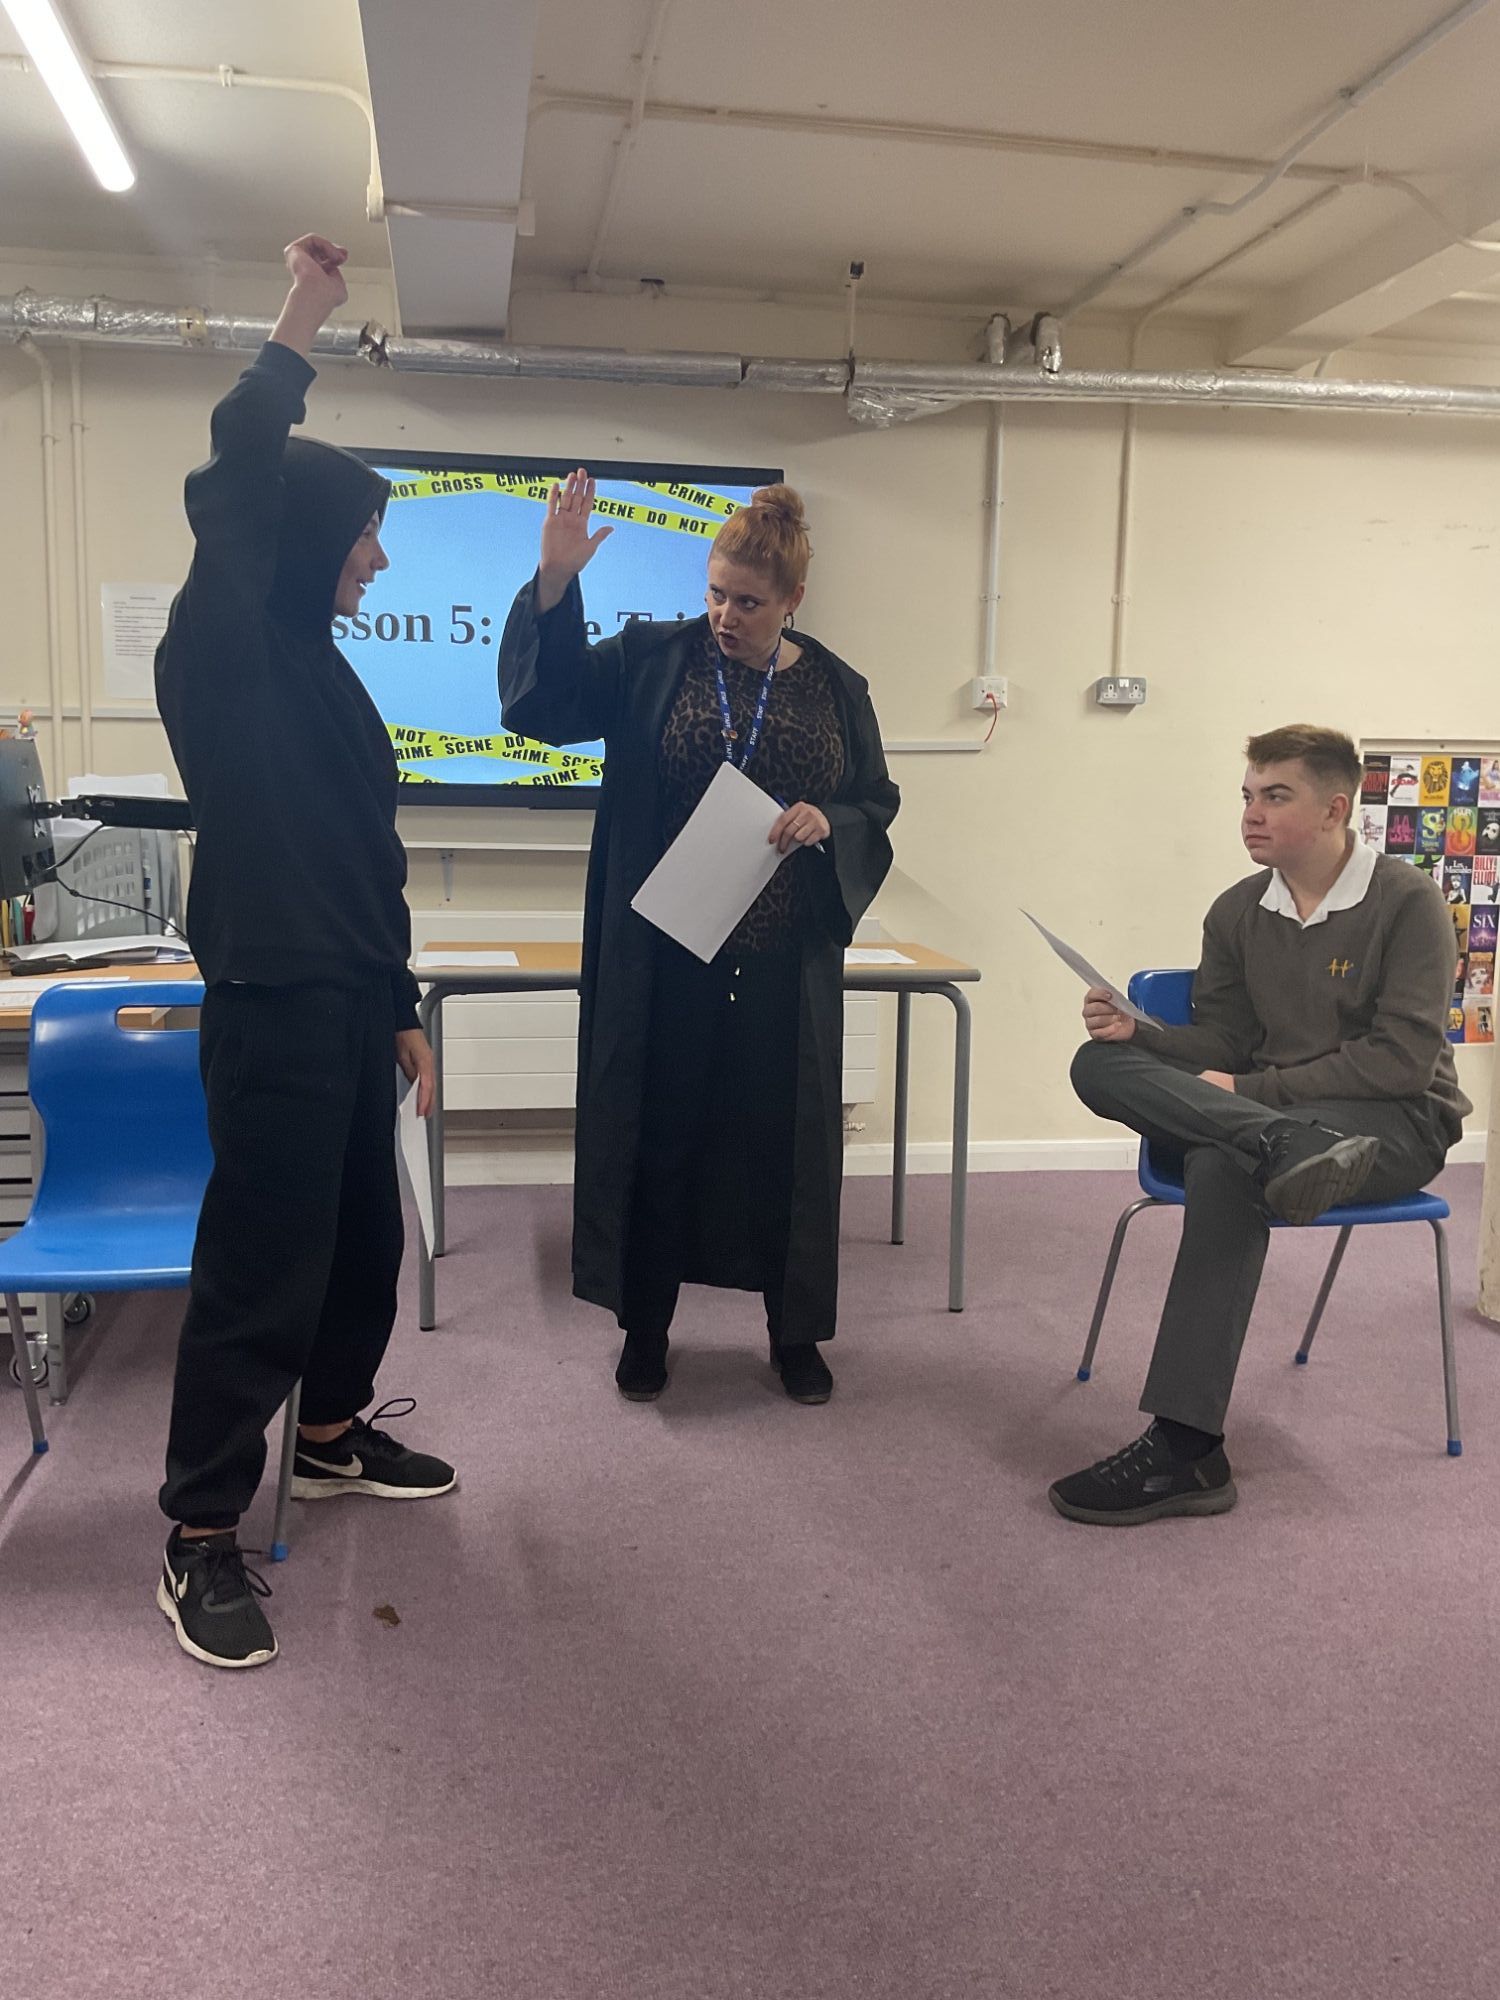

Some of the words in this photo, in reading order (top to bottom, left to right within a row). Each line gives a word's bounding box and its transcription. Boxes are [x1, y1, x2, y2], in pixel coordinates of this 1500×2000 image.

[431, 476, 484, 494] CROSS
[668, 482, 715, 508] CRIME
[646, 510, 668, 526] DO
[678, 517, 709, 534] NOT
[332, 611, 434, 643] sson
[450, 604, 492, 645] 5:
[395, 728, 426, 743] NOT
[749, 727, 759, 746] STAFF
[395, 745, 434, 760] RIME
[446, 738, 493, 755] SCENE
[505, 736, 525, 748] DO
[532, 769, 580, 785] CRIME
[1474, 856, 1492, 870] BILLY
[1473, 870, 1496, 886] ELLIOT
[1472, 914, 1495, 929] SIX
